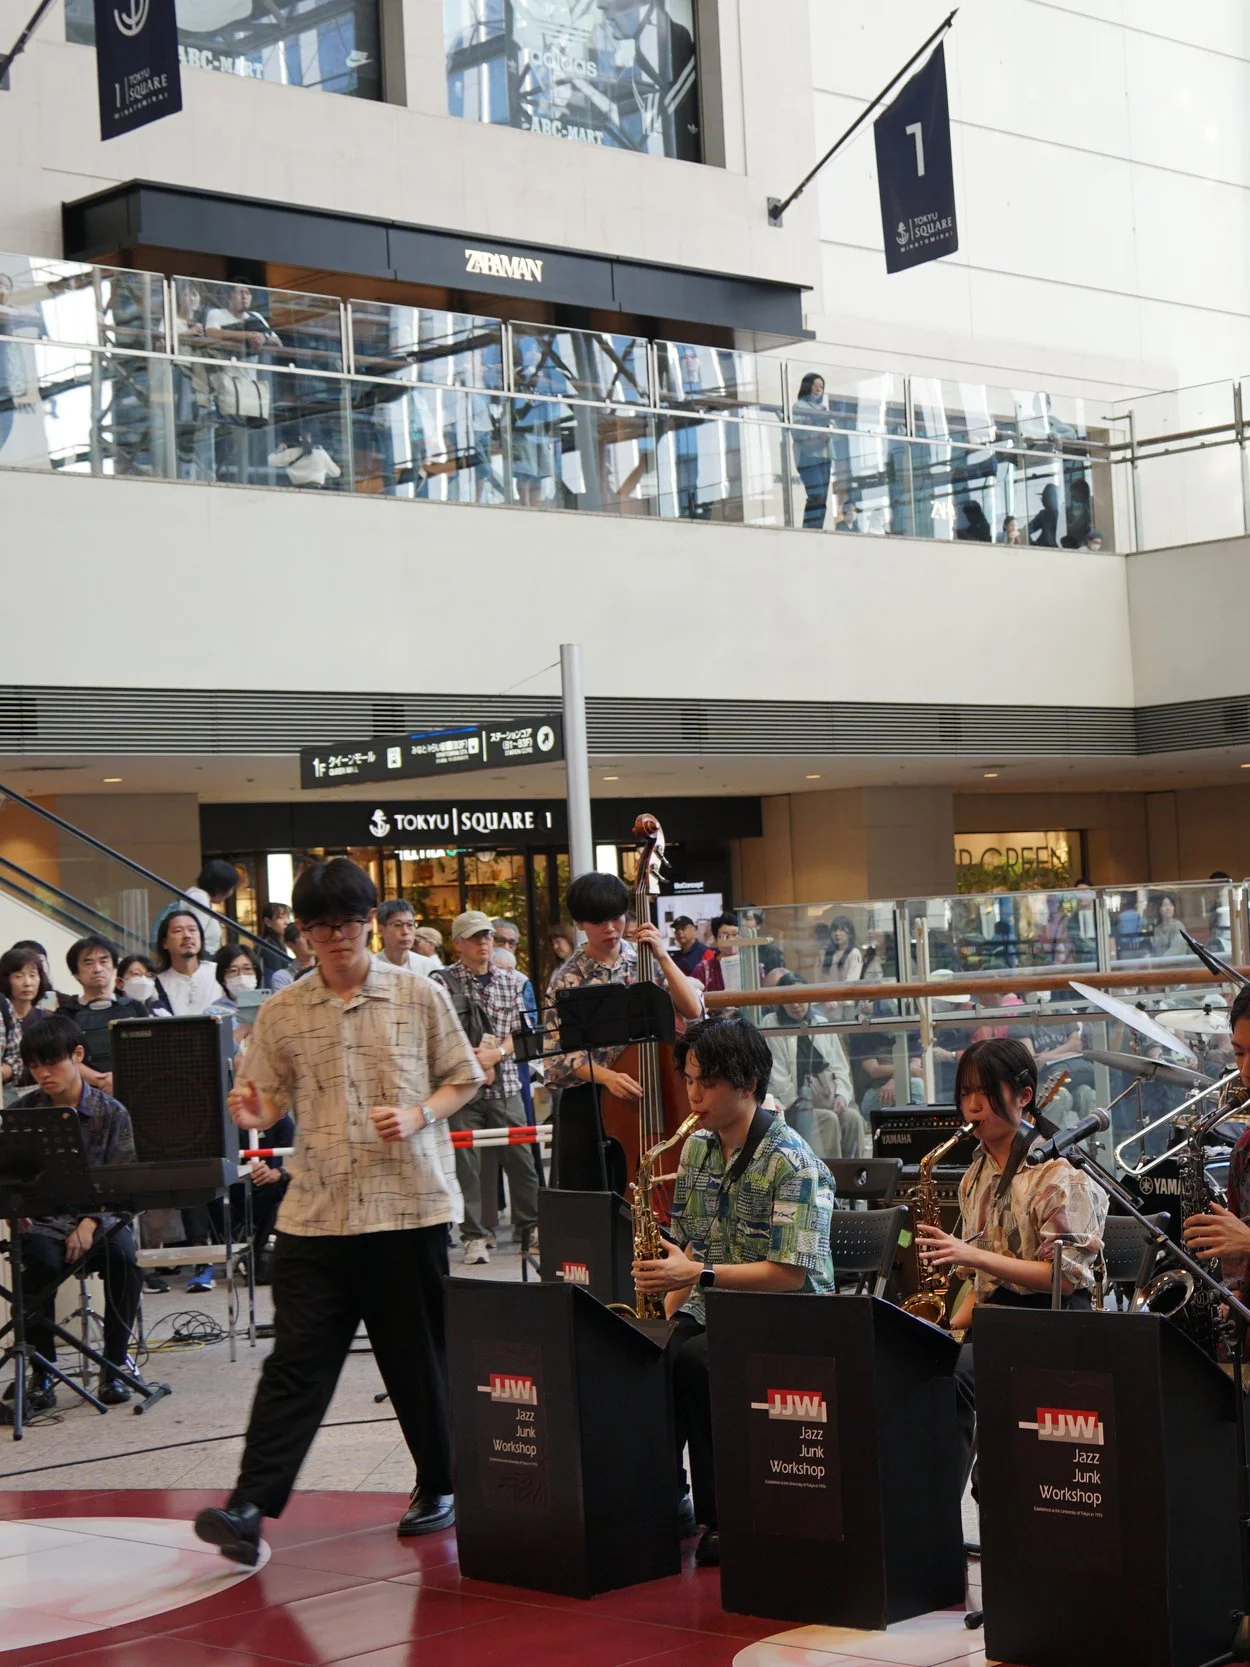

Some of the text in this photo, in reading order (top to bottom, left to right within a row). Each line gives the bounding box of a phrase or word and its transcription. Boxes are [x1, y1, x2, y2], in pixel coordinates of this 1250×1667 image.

[530, 48, 599, 78] adidas
[129, 67, 150, 85] TOKYU
[129, 74, 168, 101] SQUARE
[530, 116, 604, 145] ABC-MART
[905, 121, 925, 177] 1
[914, 211, 938, 225] TOKYU
[914, 217, 952, 238] SQUARE
[490, 728, 533, 742] ステーションコア
[312, 757, 327, 777] 1F
[328, 751, 376, 767] クイーンモール
[394, 814, 449, 831] TOKYU
[461, 811, 535, 833] SQUARE
[881, 1134, 912, 1144] YAMAHA
[516, 1408, 535, 1421] Jazz
[516, 1425, 536, 1438] Junk
[800, 1426, 823, 1440] Jazz
[493, 1438, 537, 1458] Workshop
[800, 1444, 824, 1458] Junk
[1073, 1449, 1100, 1464] Jazz
[770, 1460, 825, 1480] Workshop
[1073, 1468, 1101, 1484] Junk
[1039, 1484, 1102, 1508] Workshop
